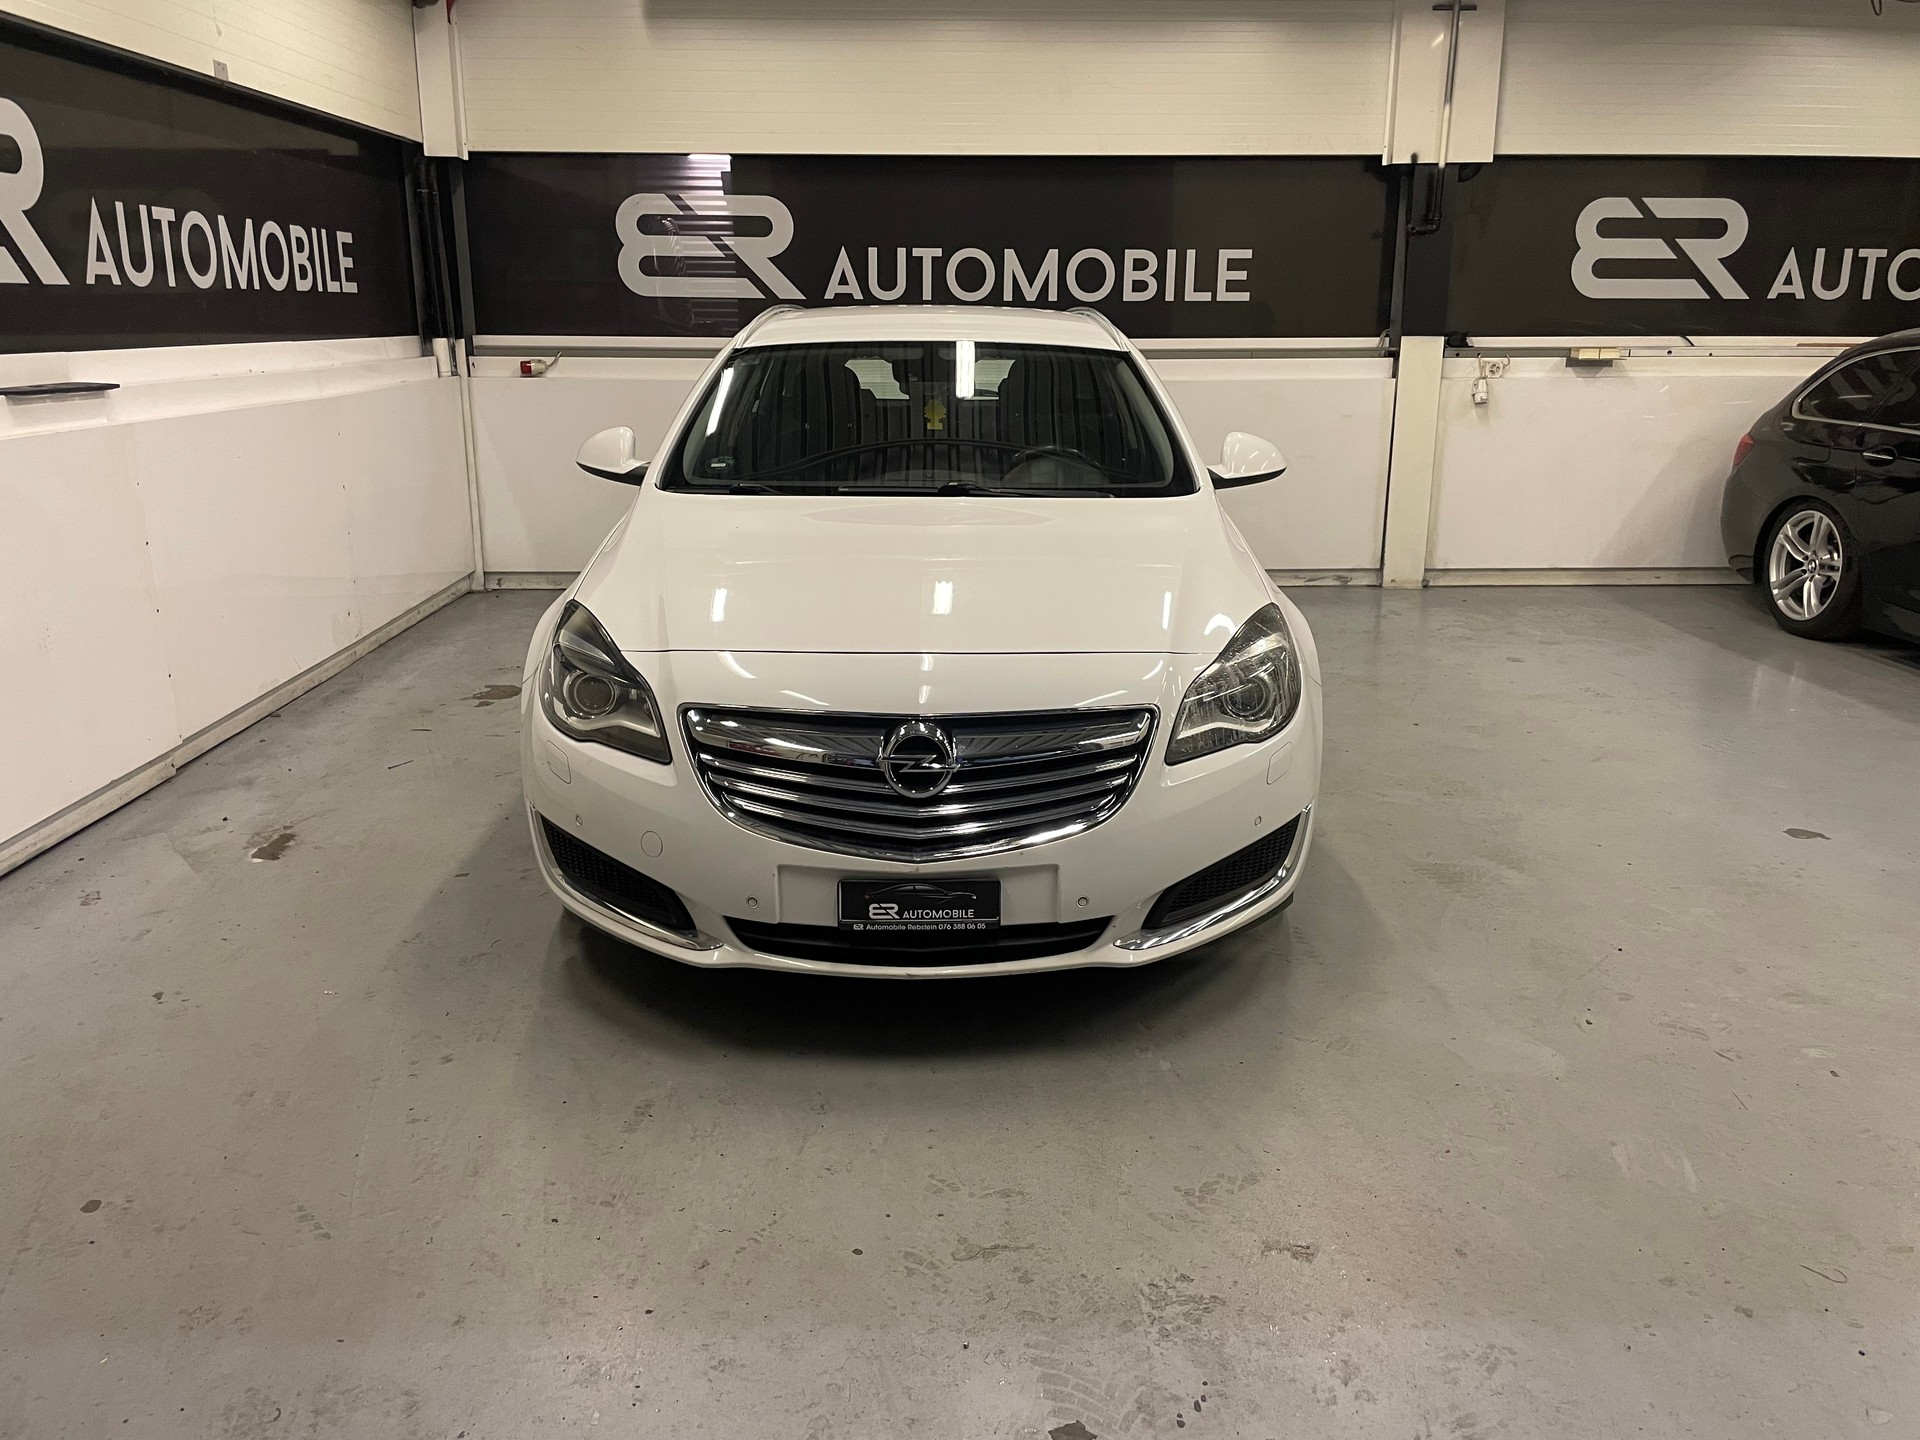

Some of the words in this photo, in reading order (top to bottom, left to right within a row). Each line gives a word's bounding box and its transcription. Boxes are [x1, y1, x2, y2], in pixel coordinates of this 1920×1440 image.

[86, 196, 359, 294] AUTOMOBILE
[824, 245, 1253, 302] AUTOMOBILE
[866, 923, 906, 931] Automobile
[902, 909, 975, 919] AUTOMOBILE
